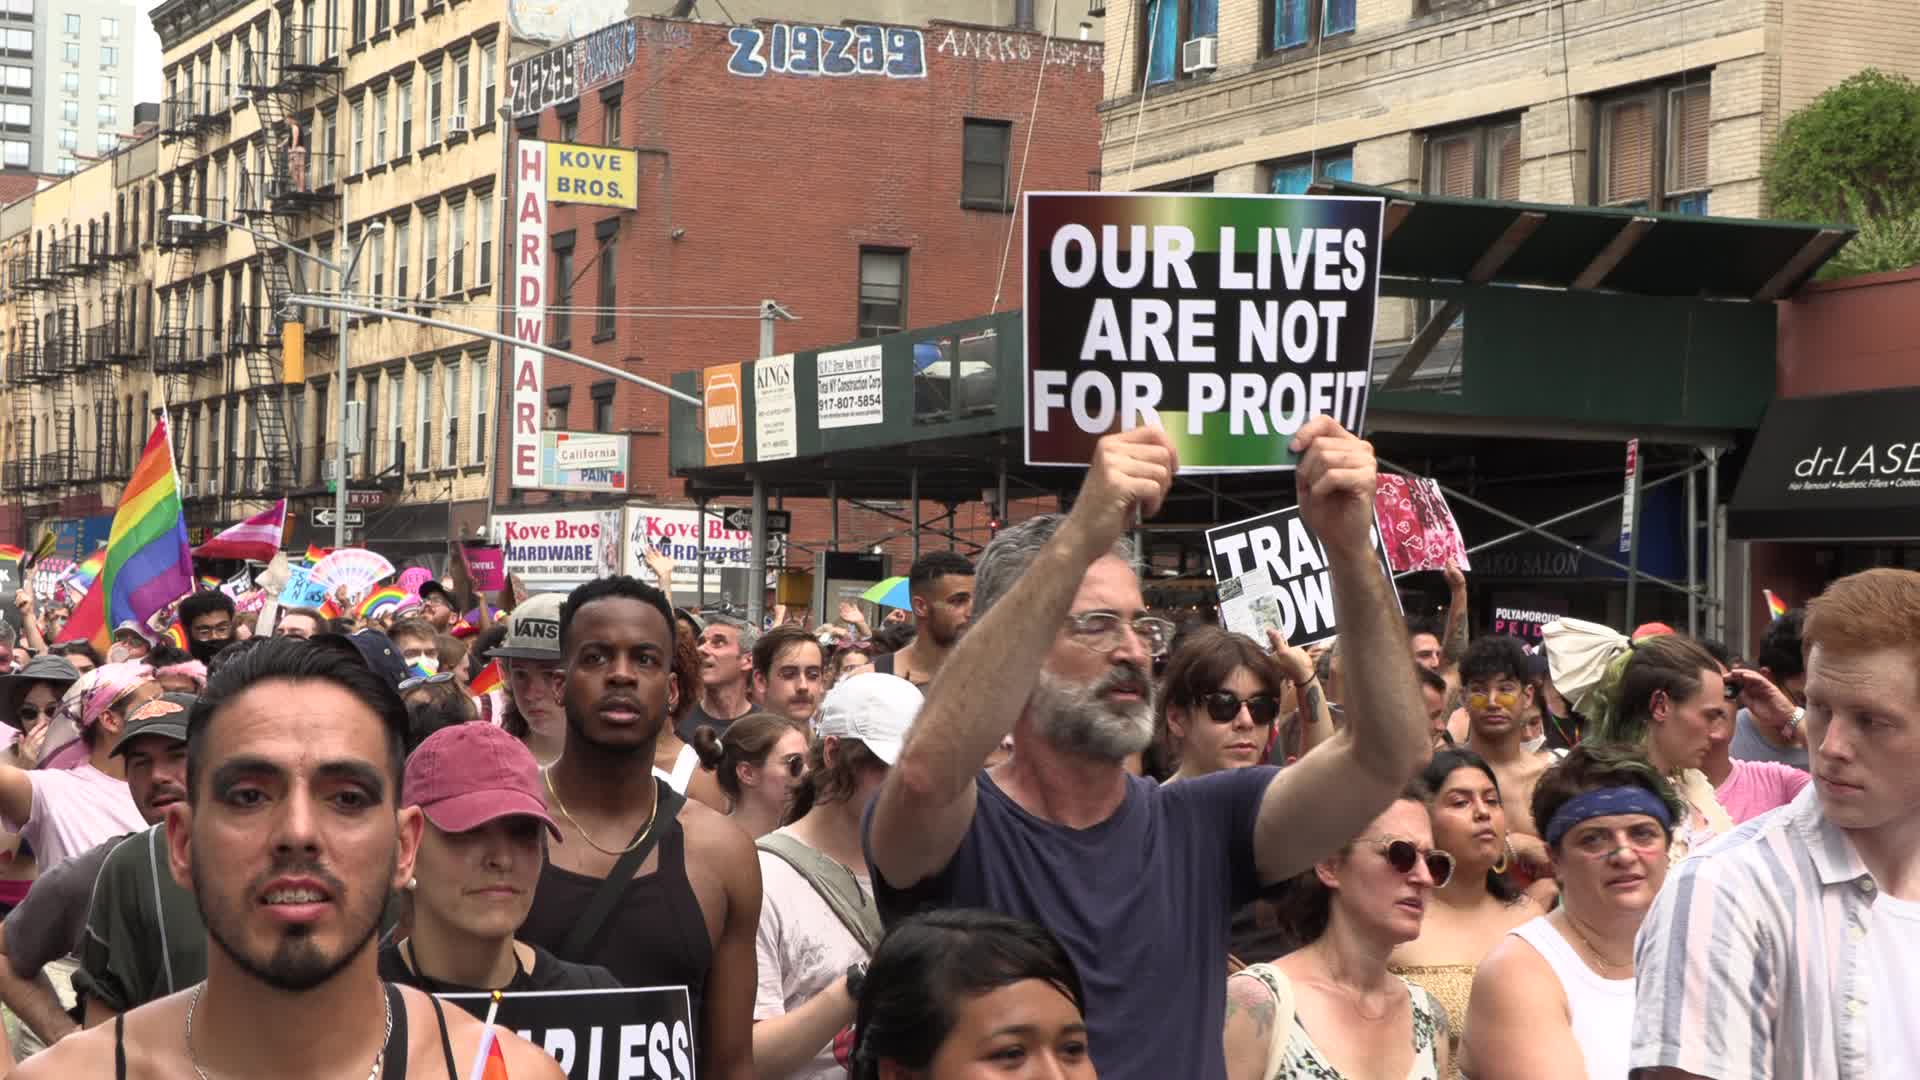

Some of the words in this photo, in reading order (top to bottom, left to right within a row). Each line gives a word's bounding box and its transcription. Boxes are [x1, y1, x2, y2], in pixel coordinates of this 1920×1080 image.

[560, 151, 622, 171] KOVE
[557, 176, 624, 199] BROS.
[1050, 222, 1197, 289] OUR
[1219, 226, 1367, 291] LIVES
[517, 149, 542, 477] HARDWARE
[1079, 298, 1217, 362] ARE
[1238, 299, 1348, 364] NOT
[757, 363, 790, 389] KINGS
[837, 377, 868, 393] Construction
[818, 393, 881, 412] 917-807-5854
[1033, 369, 1163, 434] FOR
[1187, 370, 1368, 436] PROFIT
[561, 447, 617, 461] California
[505, 521, 550, 541] Kove
[555, 519, 600, 540] Bros
[646, 516, 699, 538] Kove
[507, 544, 593, 561] HARDWARE
[1496, 607, 1560, 624] POLYAMOROUS
[514, 617, 559, 639] VANS
